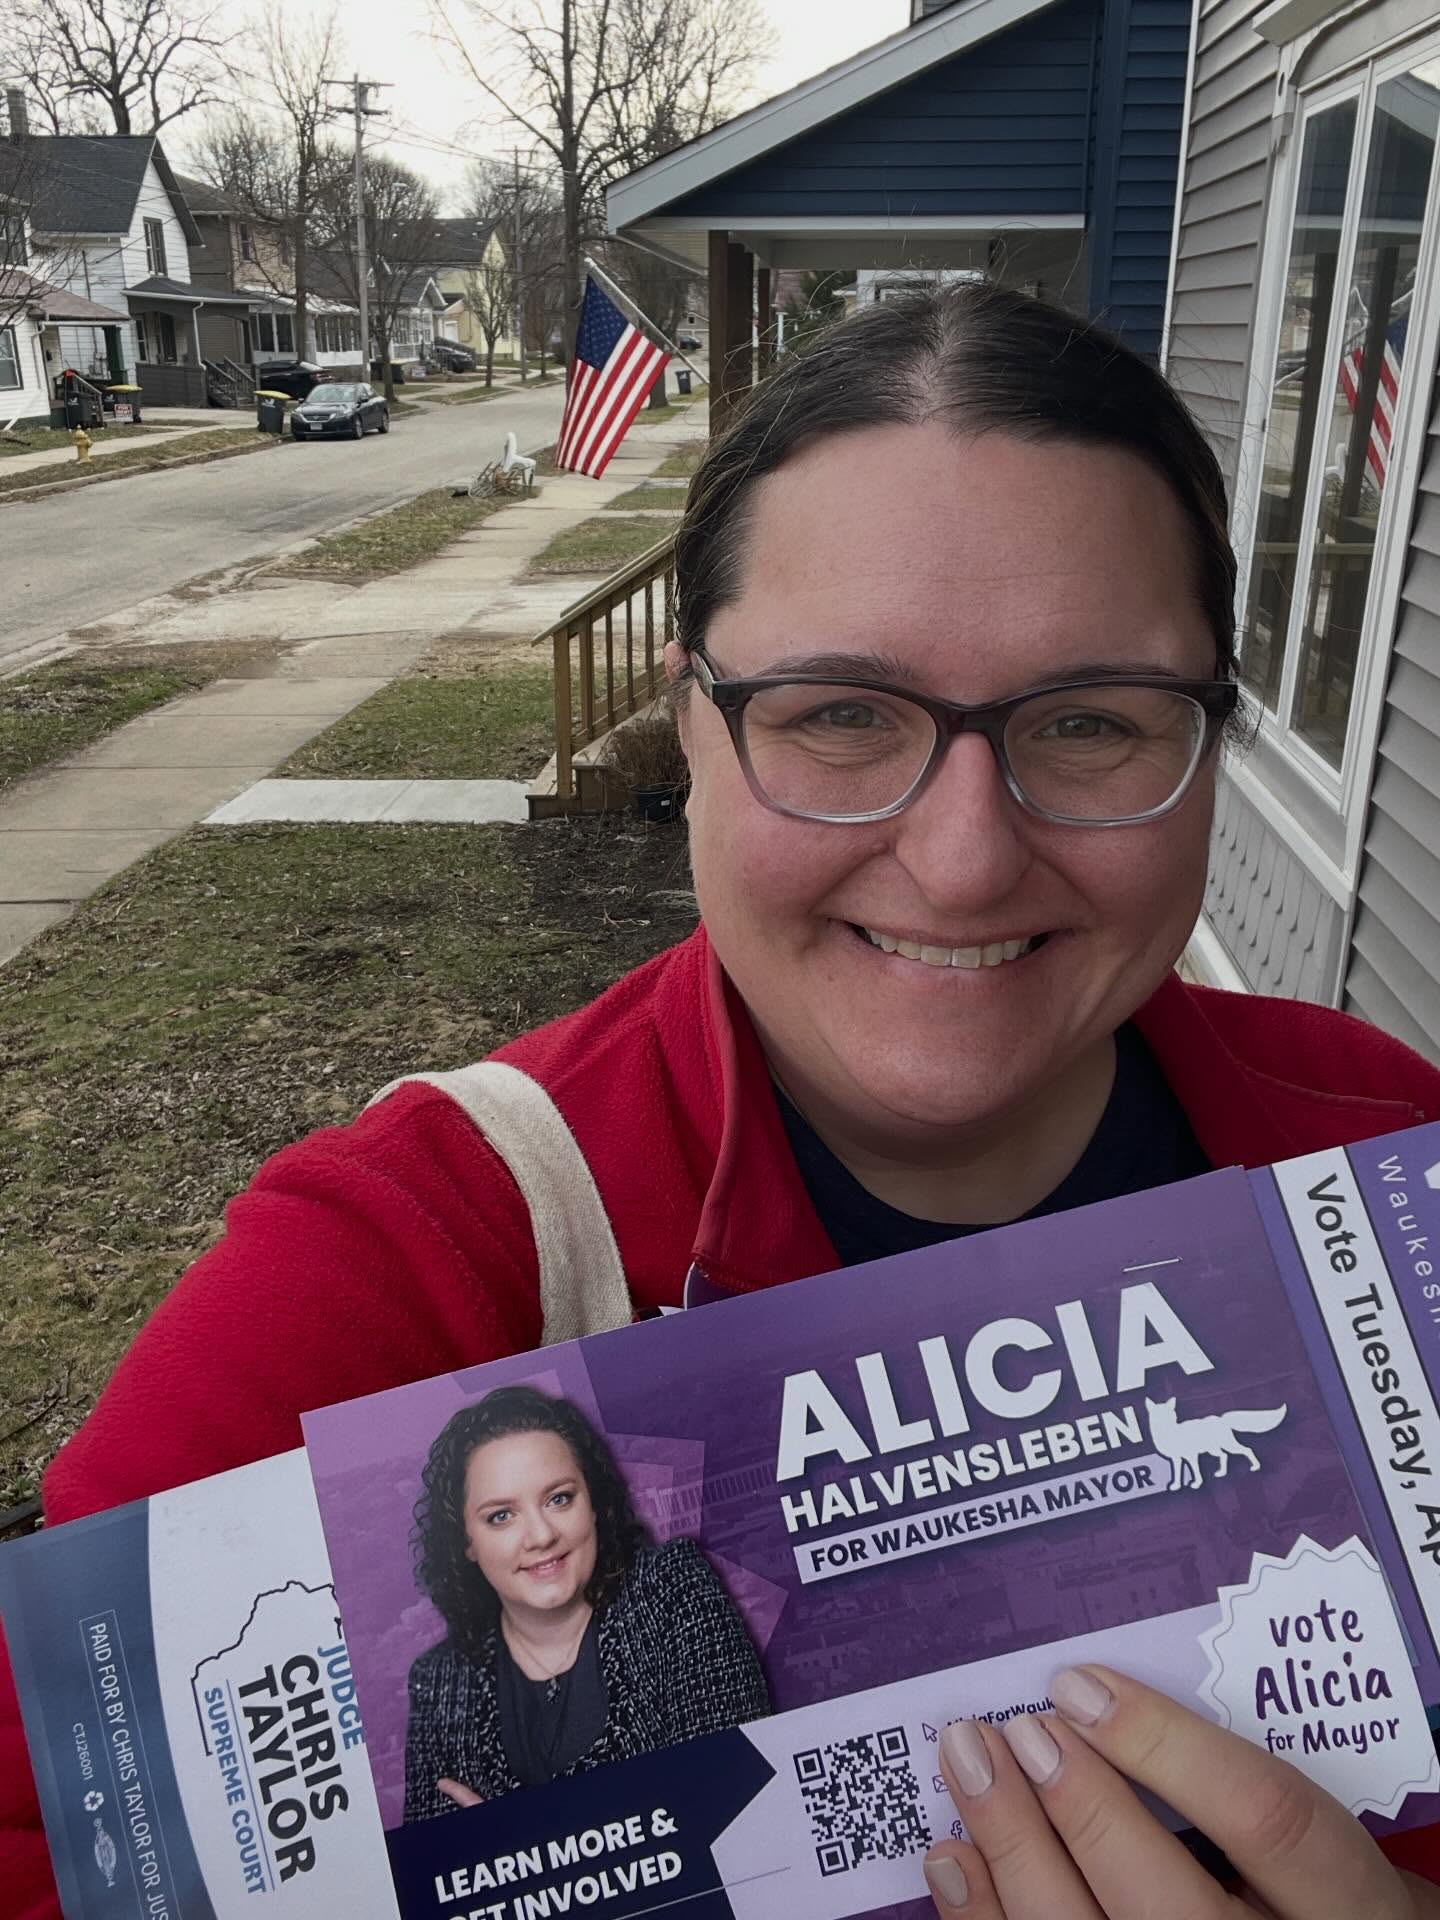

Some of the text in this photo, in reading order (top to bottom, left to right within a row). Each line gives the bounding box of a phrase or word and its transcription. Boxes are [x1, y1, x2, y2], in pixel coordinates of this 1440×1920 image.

[1307, 1172, 1358, 1274] Vote
[1345, 1283, 1432, 1489] Tuesday,
[776, 1281, 1215, 1482] ALICIA
[780, 1405, 1144, 1533] HALVENSLEBEN
[808, 1463, 1155, 1573] FOR WAUKESHA MAYOR
[89, 1622, 112, 1662] PAID
[1269, 1599, 1364, 1647] vote
[98, 1664, 120, 1701] FOR
[106, 1702, 126, 1724] BY
[317, 1644, 365, 1750] JUDGE
[1255, 1652, 1393, 1720] Alicia
[72, 1722, 94, 1780] CTJ26001
[112, 1729, 138, 1781] CHRIS
[281, 1654, 349, 1820] CHRIS
[1265, 1718, 1400, 1754] for Mayor
[204, 1687, 267, 1894] SUPREME COURT
[238, 1664, 316, 1883] TAYLOR
[124, 1781, 152, 1850] TAYLOR
[138, 1850, 161, 1889] FOR
[435, 1808, 679, 1903] LEARN MORE &
[513, 1852, 682, 1920] INVOLVED
